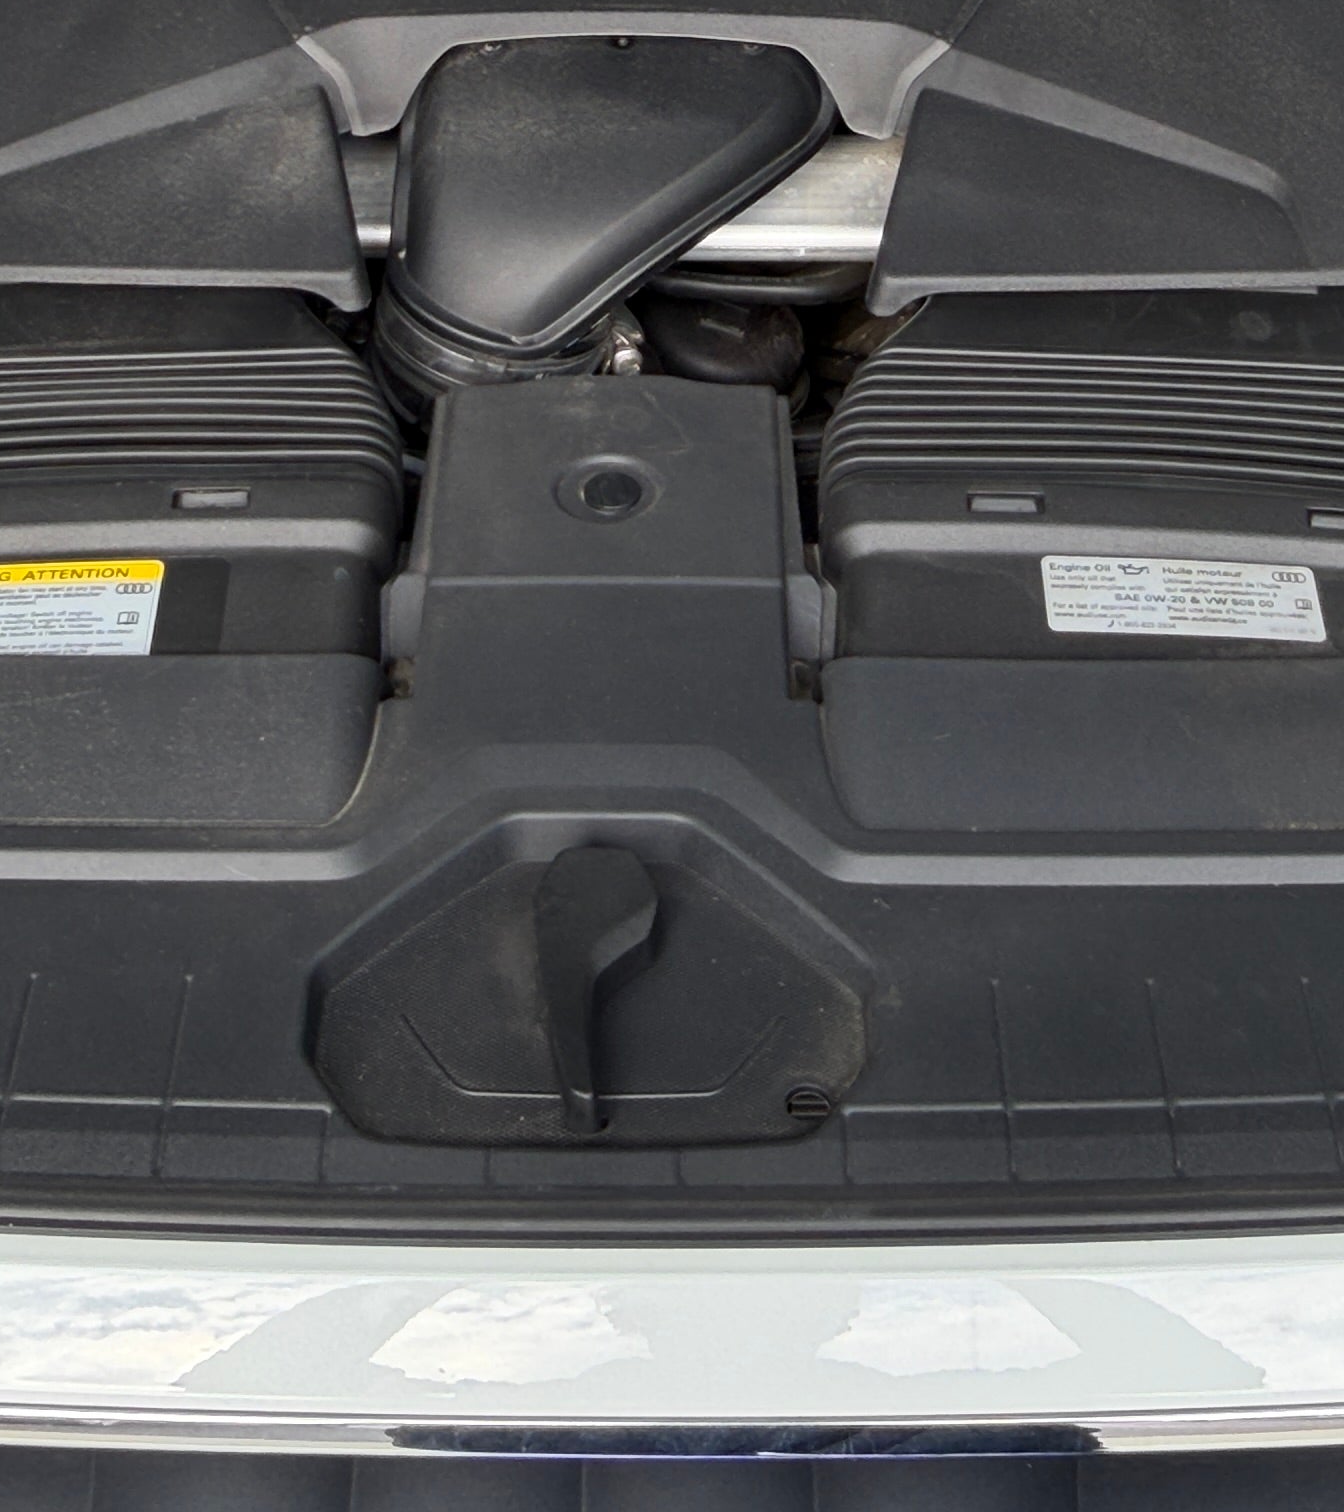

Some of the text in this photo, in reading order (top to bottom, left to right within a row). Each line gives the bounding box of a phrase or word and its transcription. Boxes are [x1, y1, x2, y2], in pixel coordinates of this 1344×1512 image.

[1049, 563, 1091, 572] Engine
[1162, 567, 1242, 577] Huile moteur
[22, 567, 130, 581] ATTENTION
[1115, 593, 1140, 601] SAE
[1144, 593, 1186, 604] 0W-20
[1190, 596, 1200, 604] &
[1204, 596, 1228, 606] VW
